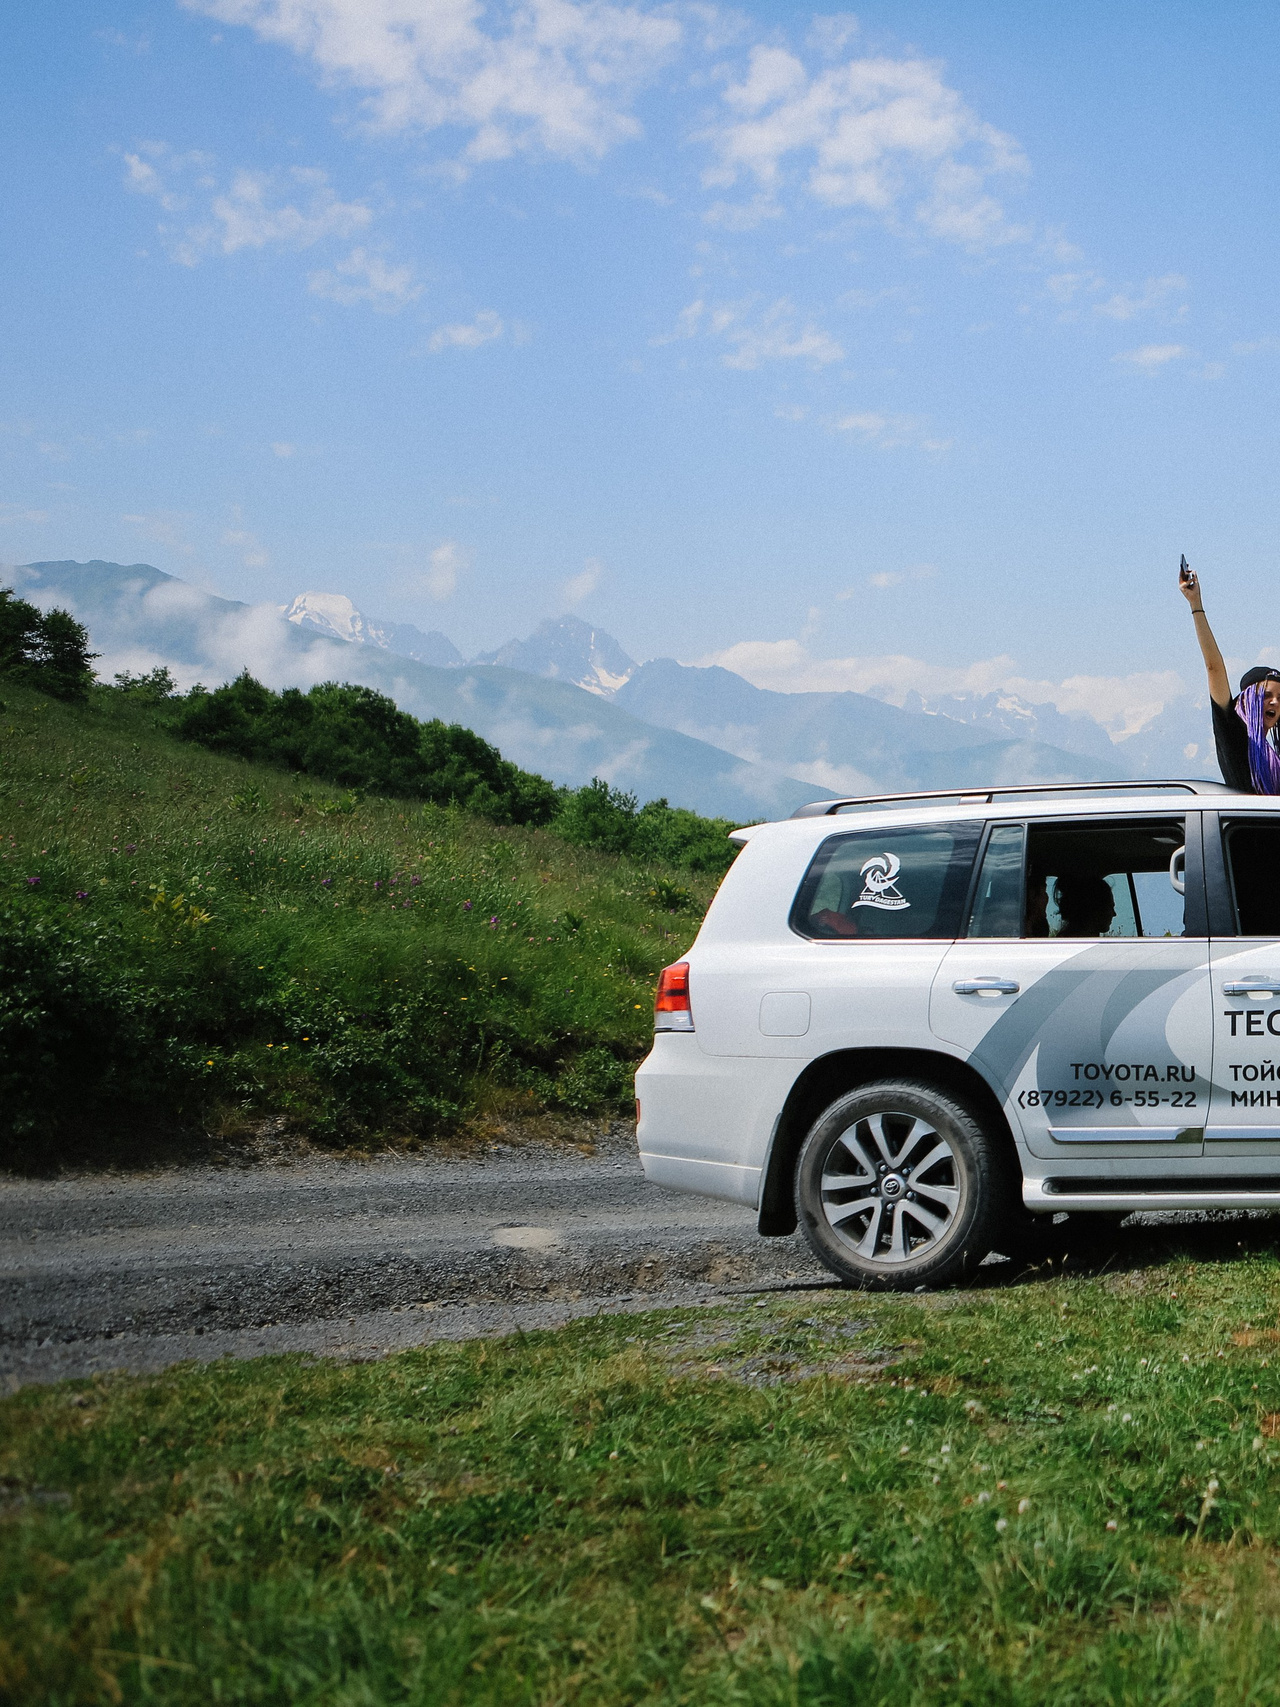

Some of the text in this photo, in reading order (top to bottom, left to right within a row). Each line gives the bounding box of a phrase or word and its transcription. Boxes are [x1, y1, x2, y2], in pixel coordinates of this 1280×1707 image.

[1069, 1062, 1196, 1083] TOYOTA.RU
[1017, 1089, 1197, 1110] (87922) 6-55-22
